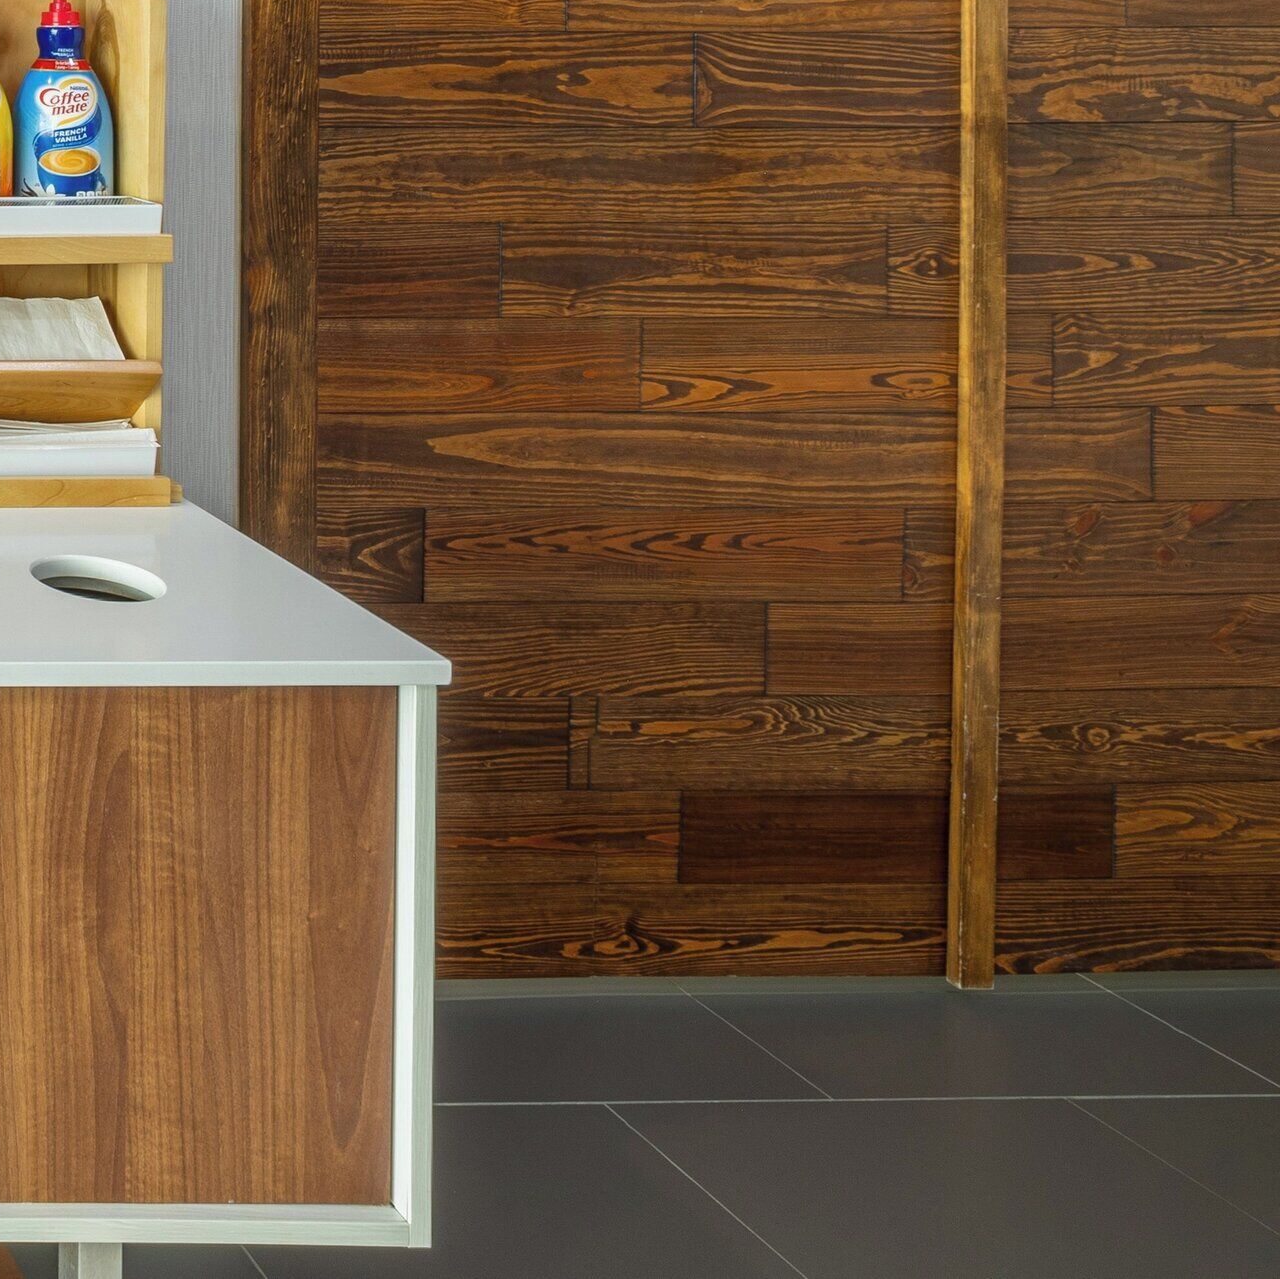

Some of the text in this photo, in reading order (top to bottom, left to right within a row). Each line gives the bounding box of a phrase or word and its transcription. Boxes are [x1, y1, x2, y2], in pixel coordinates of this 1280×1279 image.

[39, 88, 90, 107] Coffee
[52, 102, 88, 116] mate
[54, 126, 87, 138] FRENCH
[55, 134, 88, 144] VANILLA
